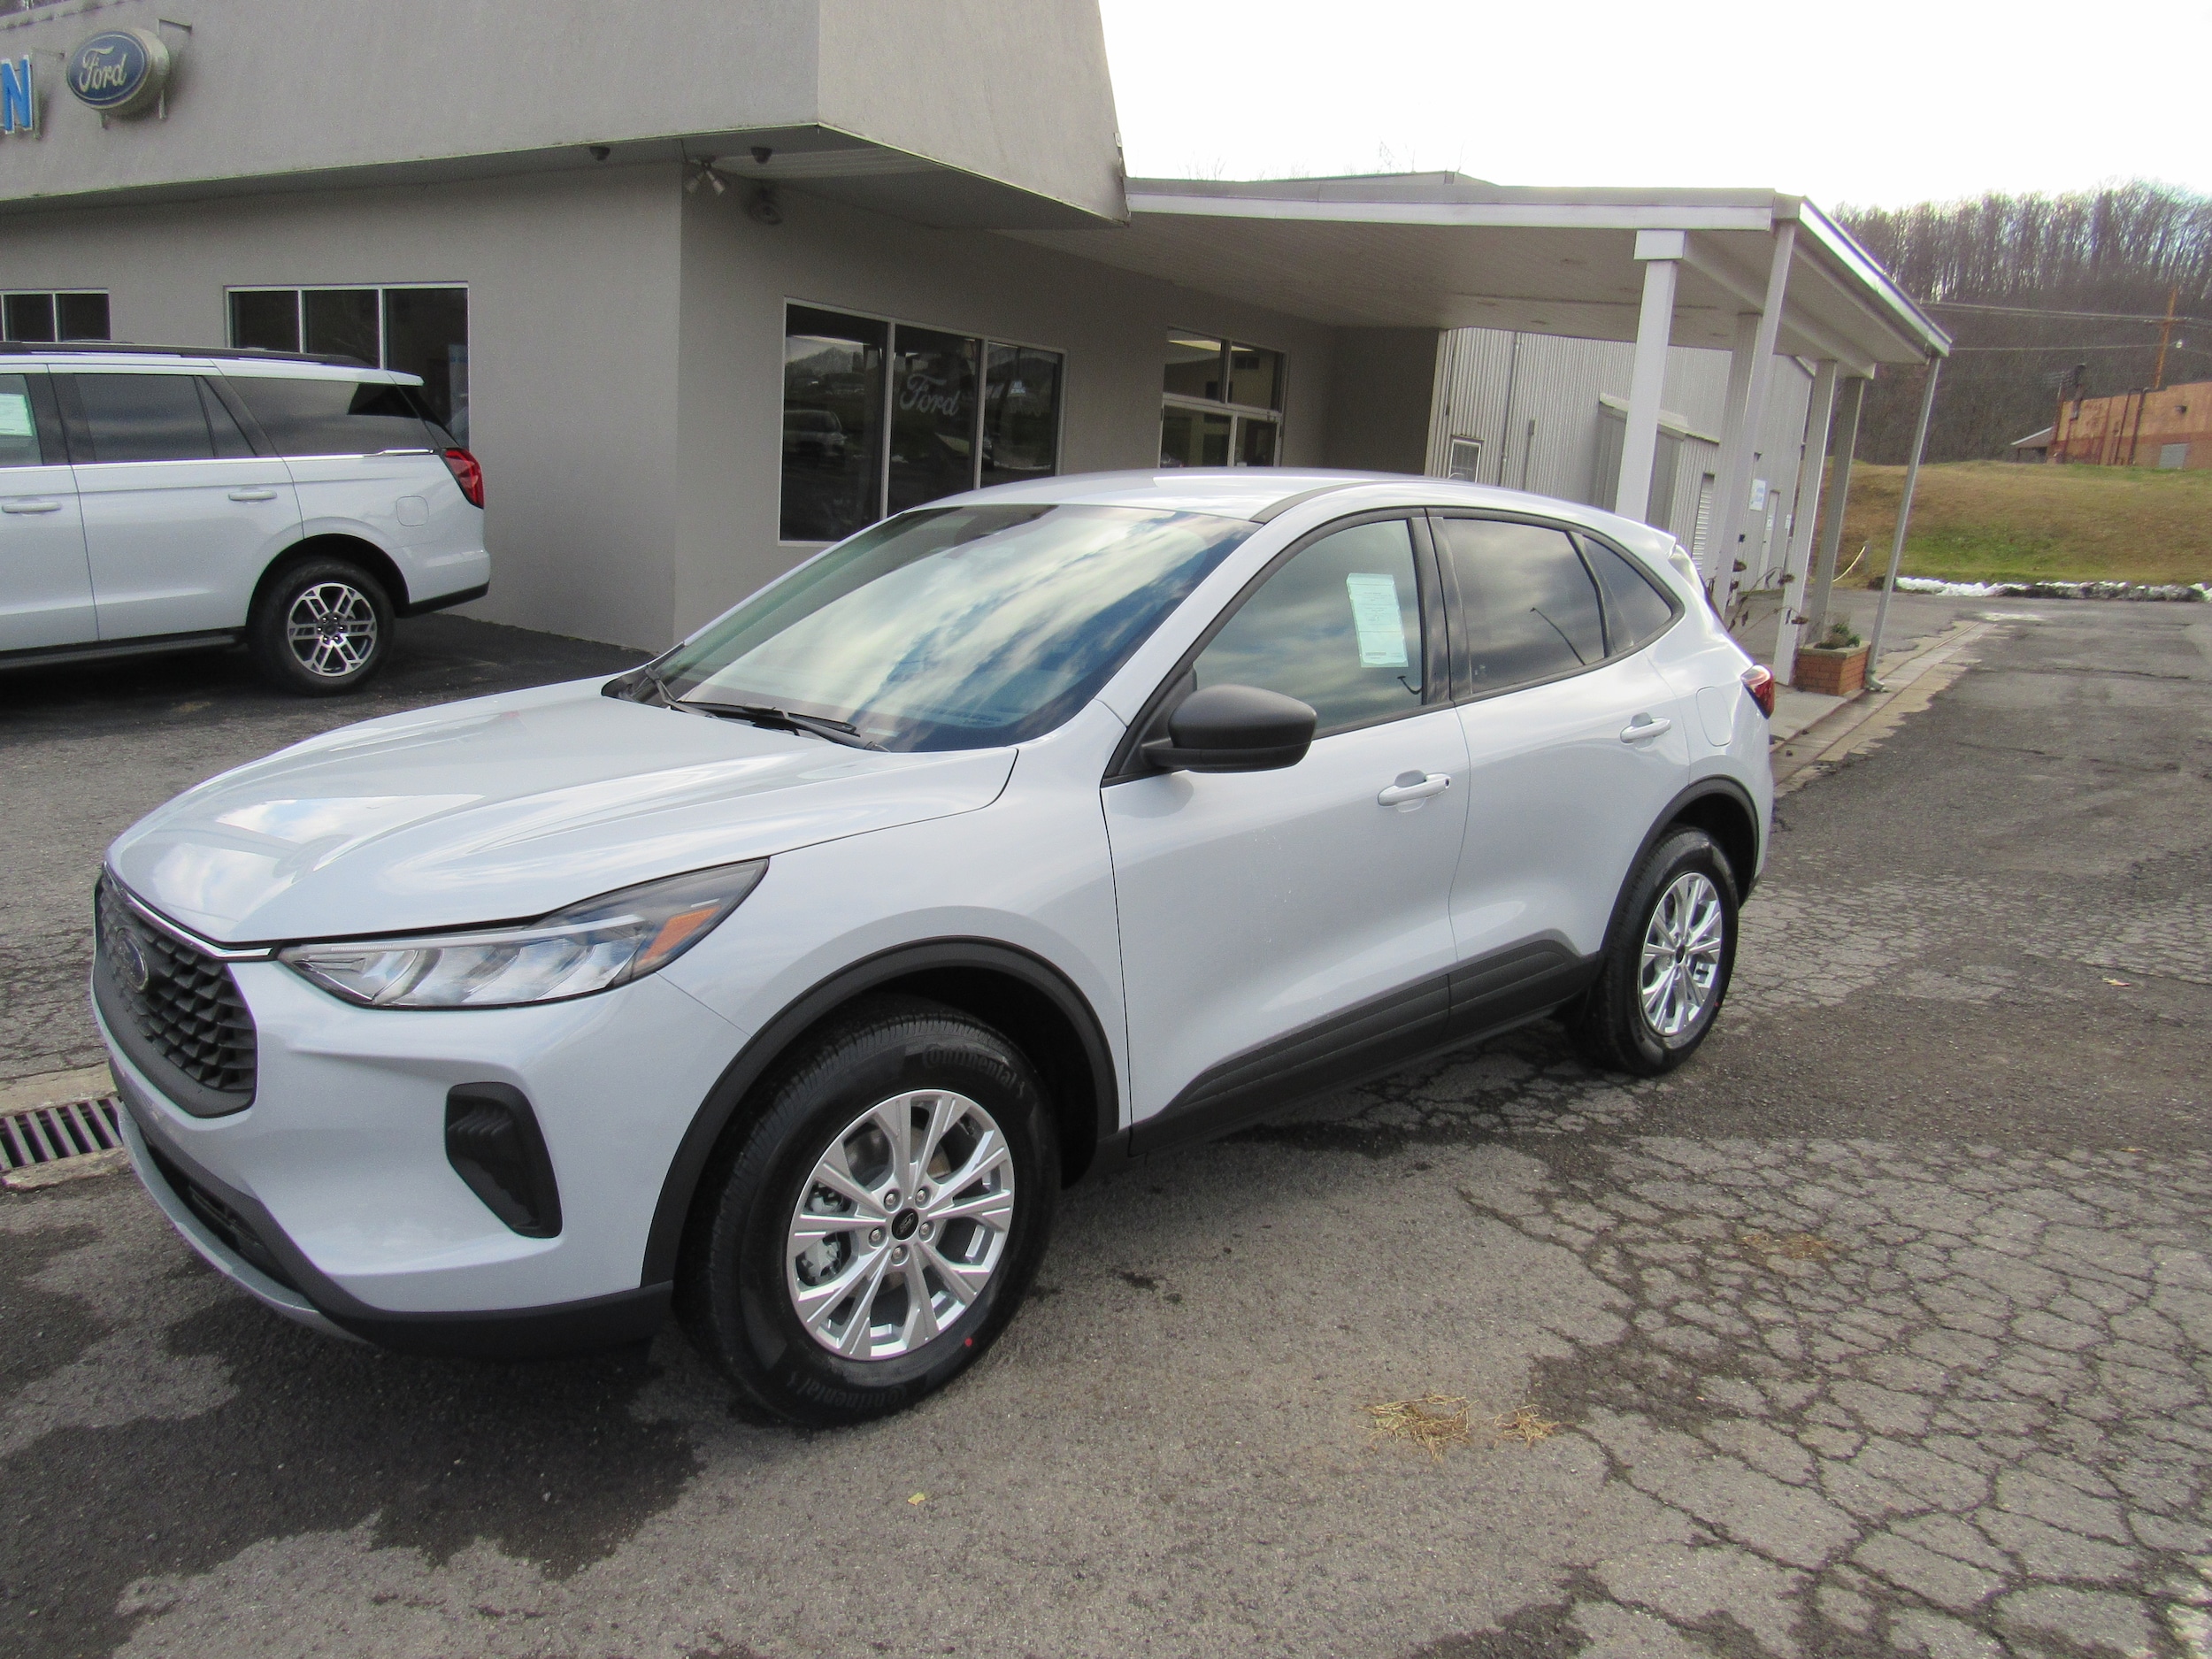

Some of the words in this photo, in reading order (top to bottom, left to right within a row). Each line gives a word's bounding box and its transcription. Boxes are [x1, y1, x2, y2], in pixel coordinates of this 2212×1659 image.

[79, 45, 127, 92] Ford
[899, 373, 962, 417] Ford
[922, 1043, 1018, 1090] Continental
